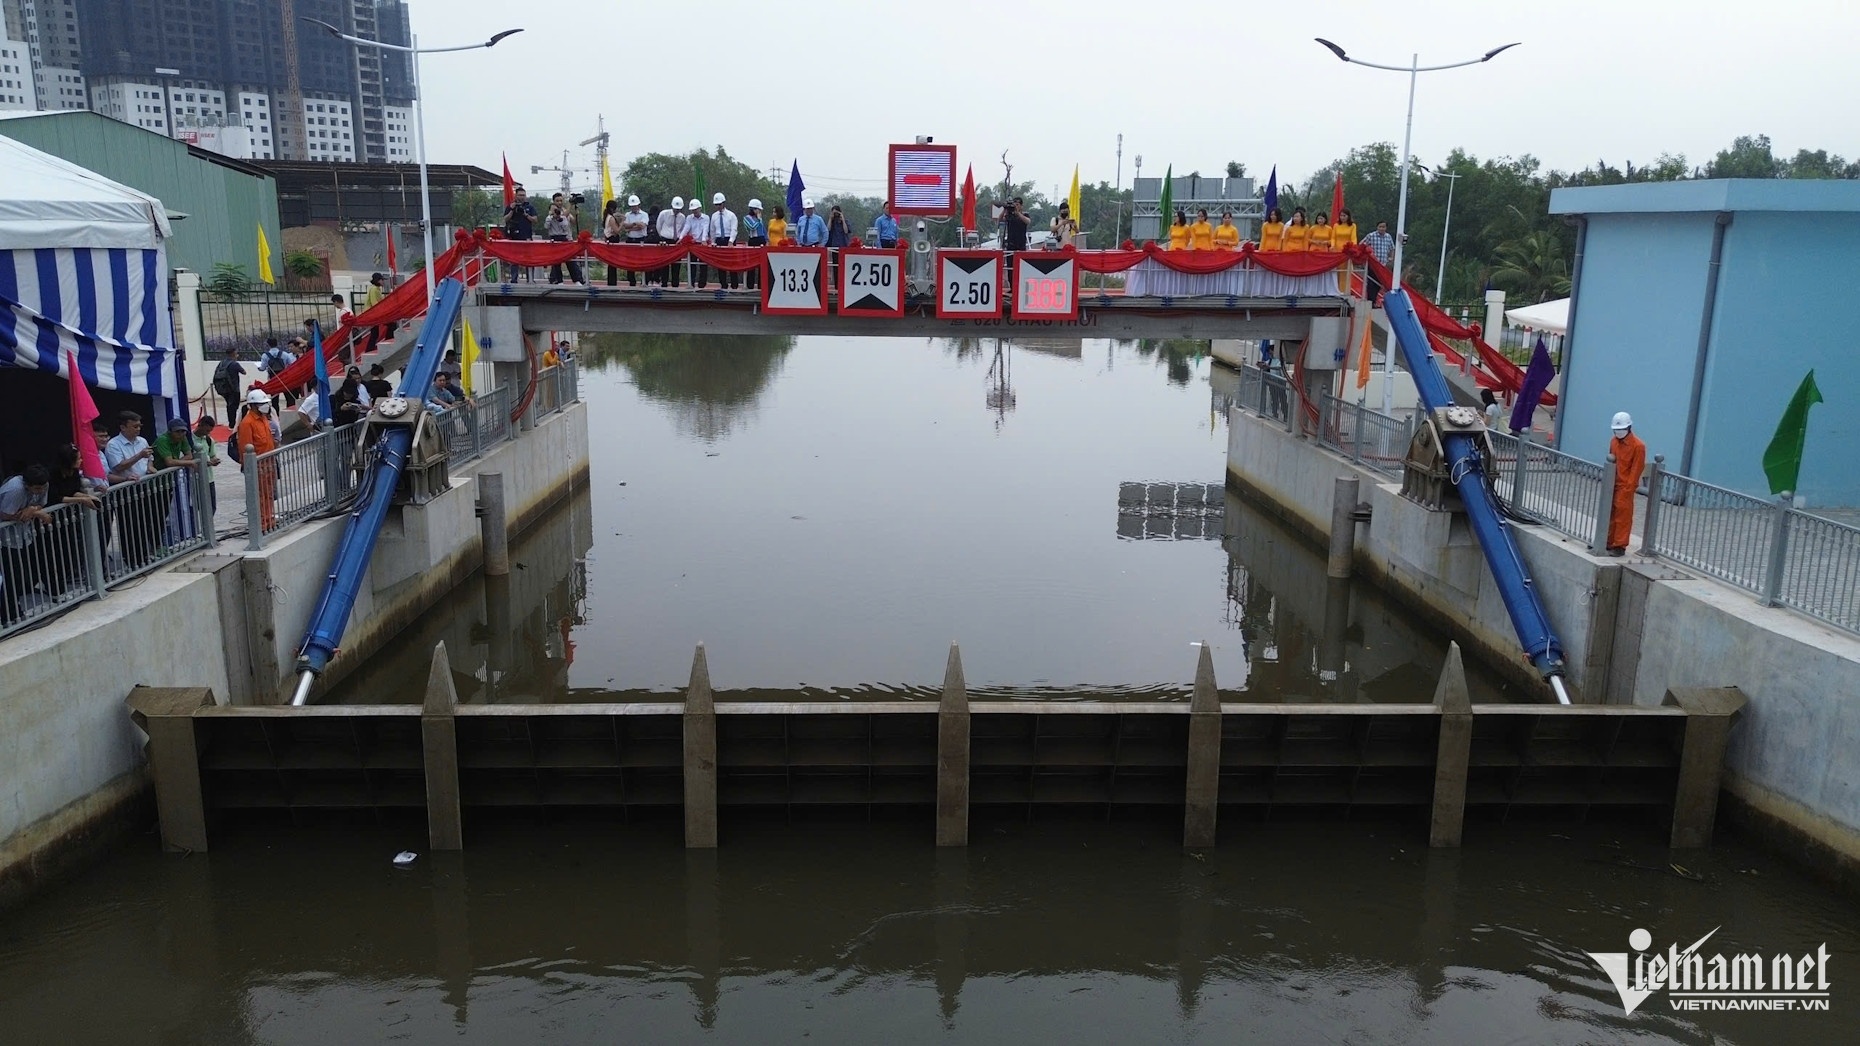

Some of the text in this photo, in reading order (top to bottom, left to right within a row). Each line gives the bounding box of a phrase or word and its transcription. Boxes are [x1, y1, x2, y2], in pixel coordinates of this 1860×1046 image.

[780, 268, 809, 292] 13.3
[851, 262, 892, 287] 2.50
[949, 281, 990, 305] 2.50
